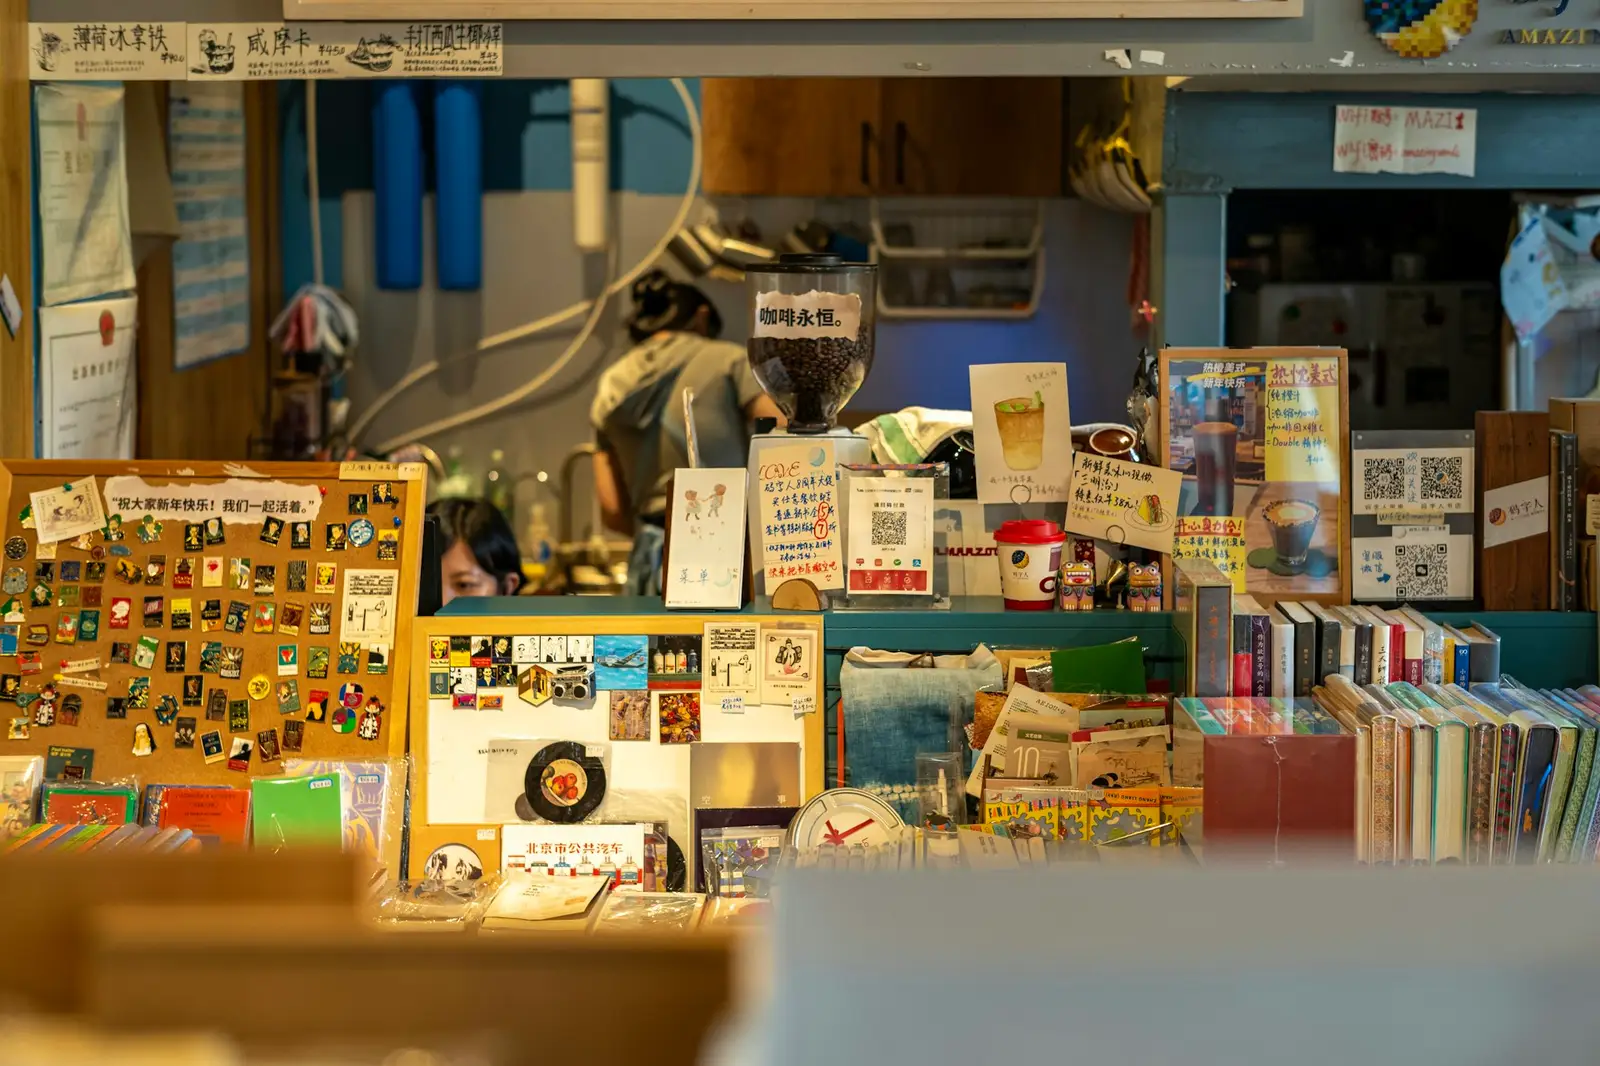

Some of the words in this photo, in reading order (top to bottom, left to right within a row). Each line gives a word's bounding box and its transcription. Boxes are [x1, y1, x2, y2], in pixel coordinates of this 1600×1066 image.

[73, 25, 168, 52] 薄荷冰拿铁
[760, 307, 841, 327] 咖啡永恒。
[1203, 362, 1246, 374] 热橙美式
[1203, 377, 1246, 388] 新年快乐
[526, 843, 623, 855] 北京市公共汽车
